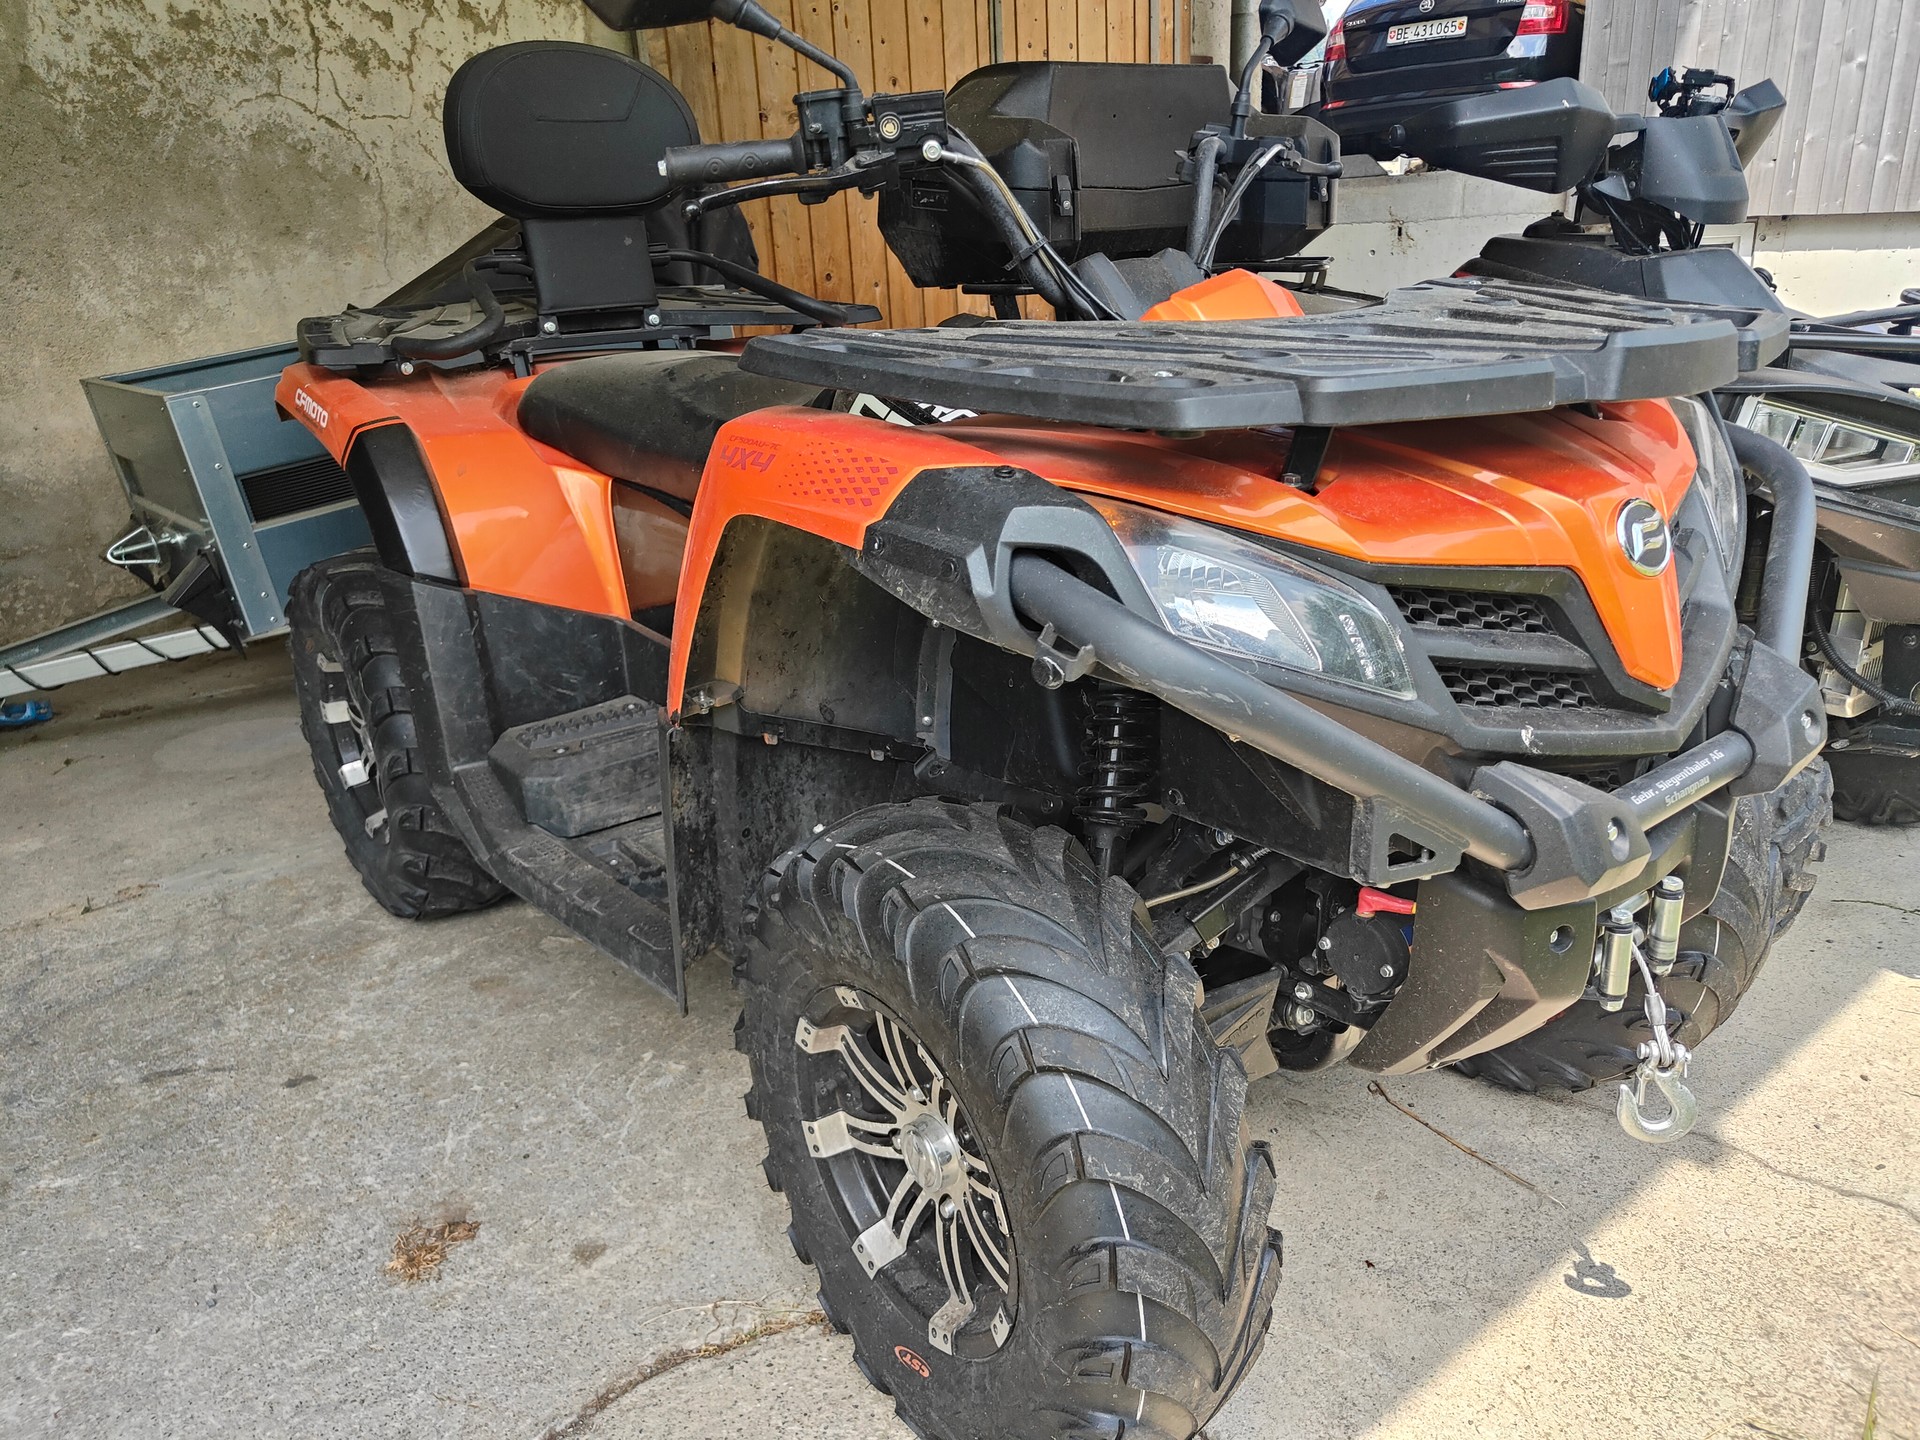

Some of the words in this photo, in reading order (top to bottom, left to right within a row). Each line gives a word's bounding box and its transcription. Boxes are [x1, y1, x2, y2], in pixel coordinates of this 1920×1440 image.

[295, 387, 329, 428] CFMOTO
[1630, 787, 1659, 805] Gebr.
[1655, 757, 1711, 791] Siegenthaler
[1708, 749, 1725, 762] AG
[1664, 775, 1711, 807] Schangnau
[902, 1353, 930, 1378] CST
